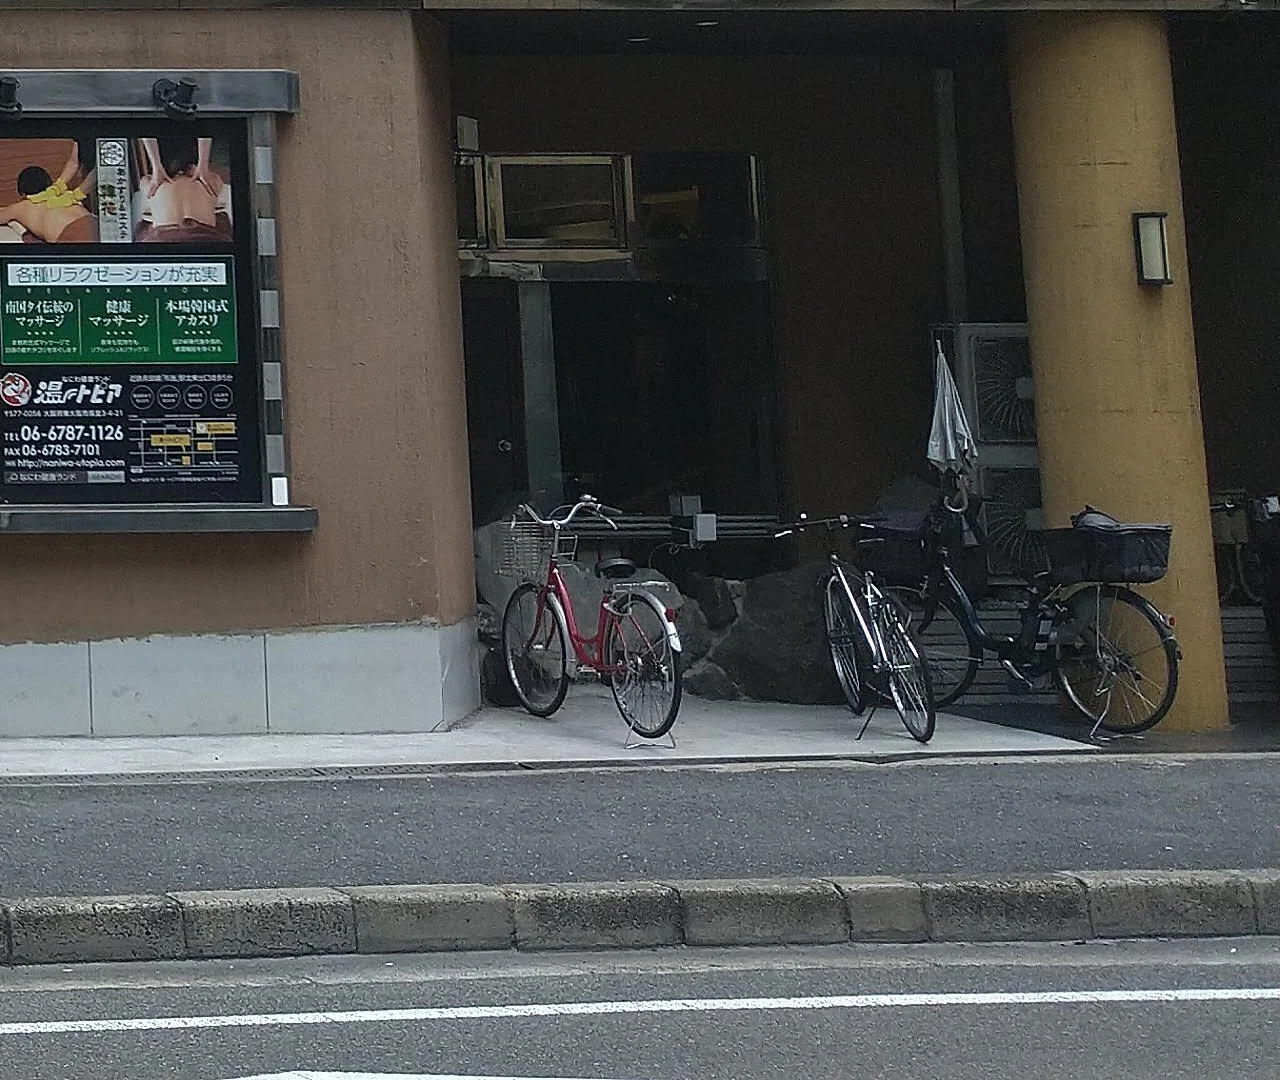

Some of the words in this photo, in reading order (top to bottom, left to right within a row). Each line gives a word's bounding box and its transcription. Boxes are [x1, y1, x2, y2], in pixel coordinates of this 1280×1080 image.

[16, 266, 218, 283] 各種リラクゼーションが充実
[105, 300, 132, 314] 健康
[15, 315, 65, 327] マッサージ
[88, 314, 150, 327] マッサージ
[174, 314, 218, 326] アカスリ
[4, 432, 20, 441] TEL
[20, 424, 124, 441] 06-6787-1126
[4, 447, 21, 456] FAX
[21, 444, 101, 456] 06-6783-7101
